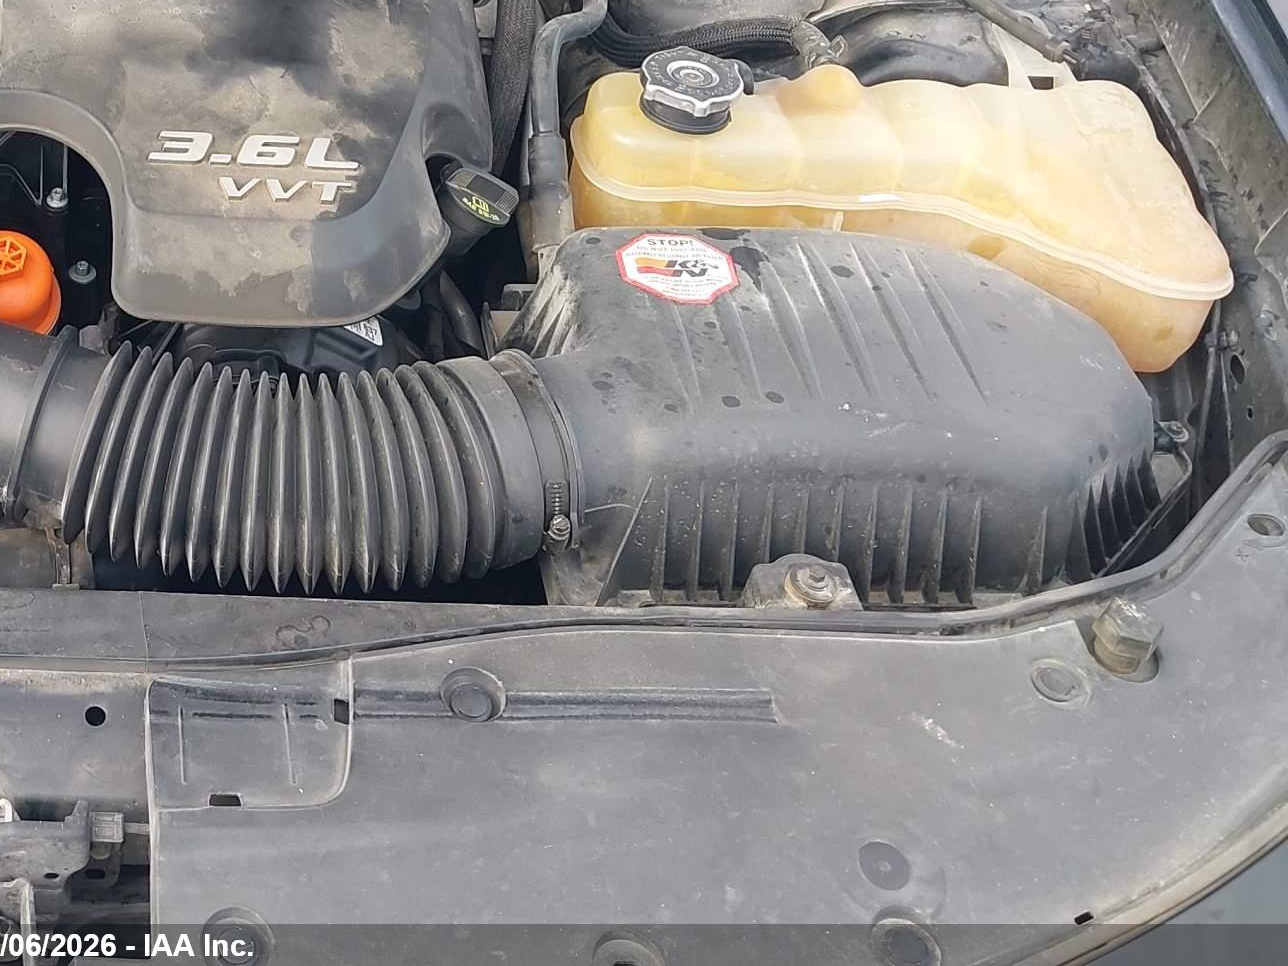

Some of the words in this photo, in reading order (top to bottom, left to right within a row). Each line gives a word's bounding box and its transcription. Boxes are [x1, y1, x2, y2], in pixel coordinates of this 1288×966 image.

[146, 130, 360, 170] 3.6L
[217, 176, 354, 204] VVT
[647, 238, 694, 246] STOP!
